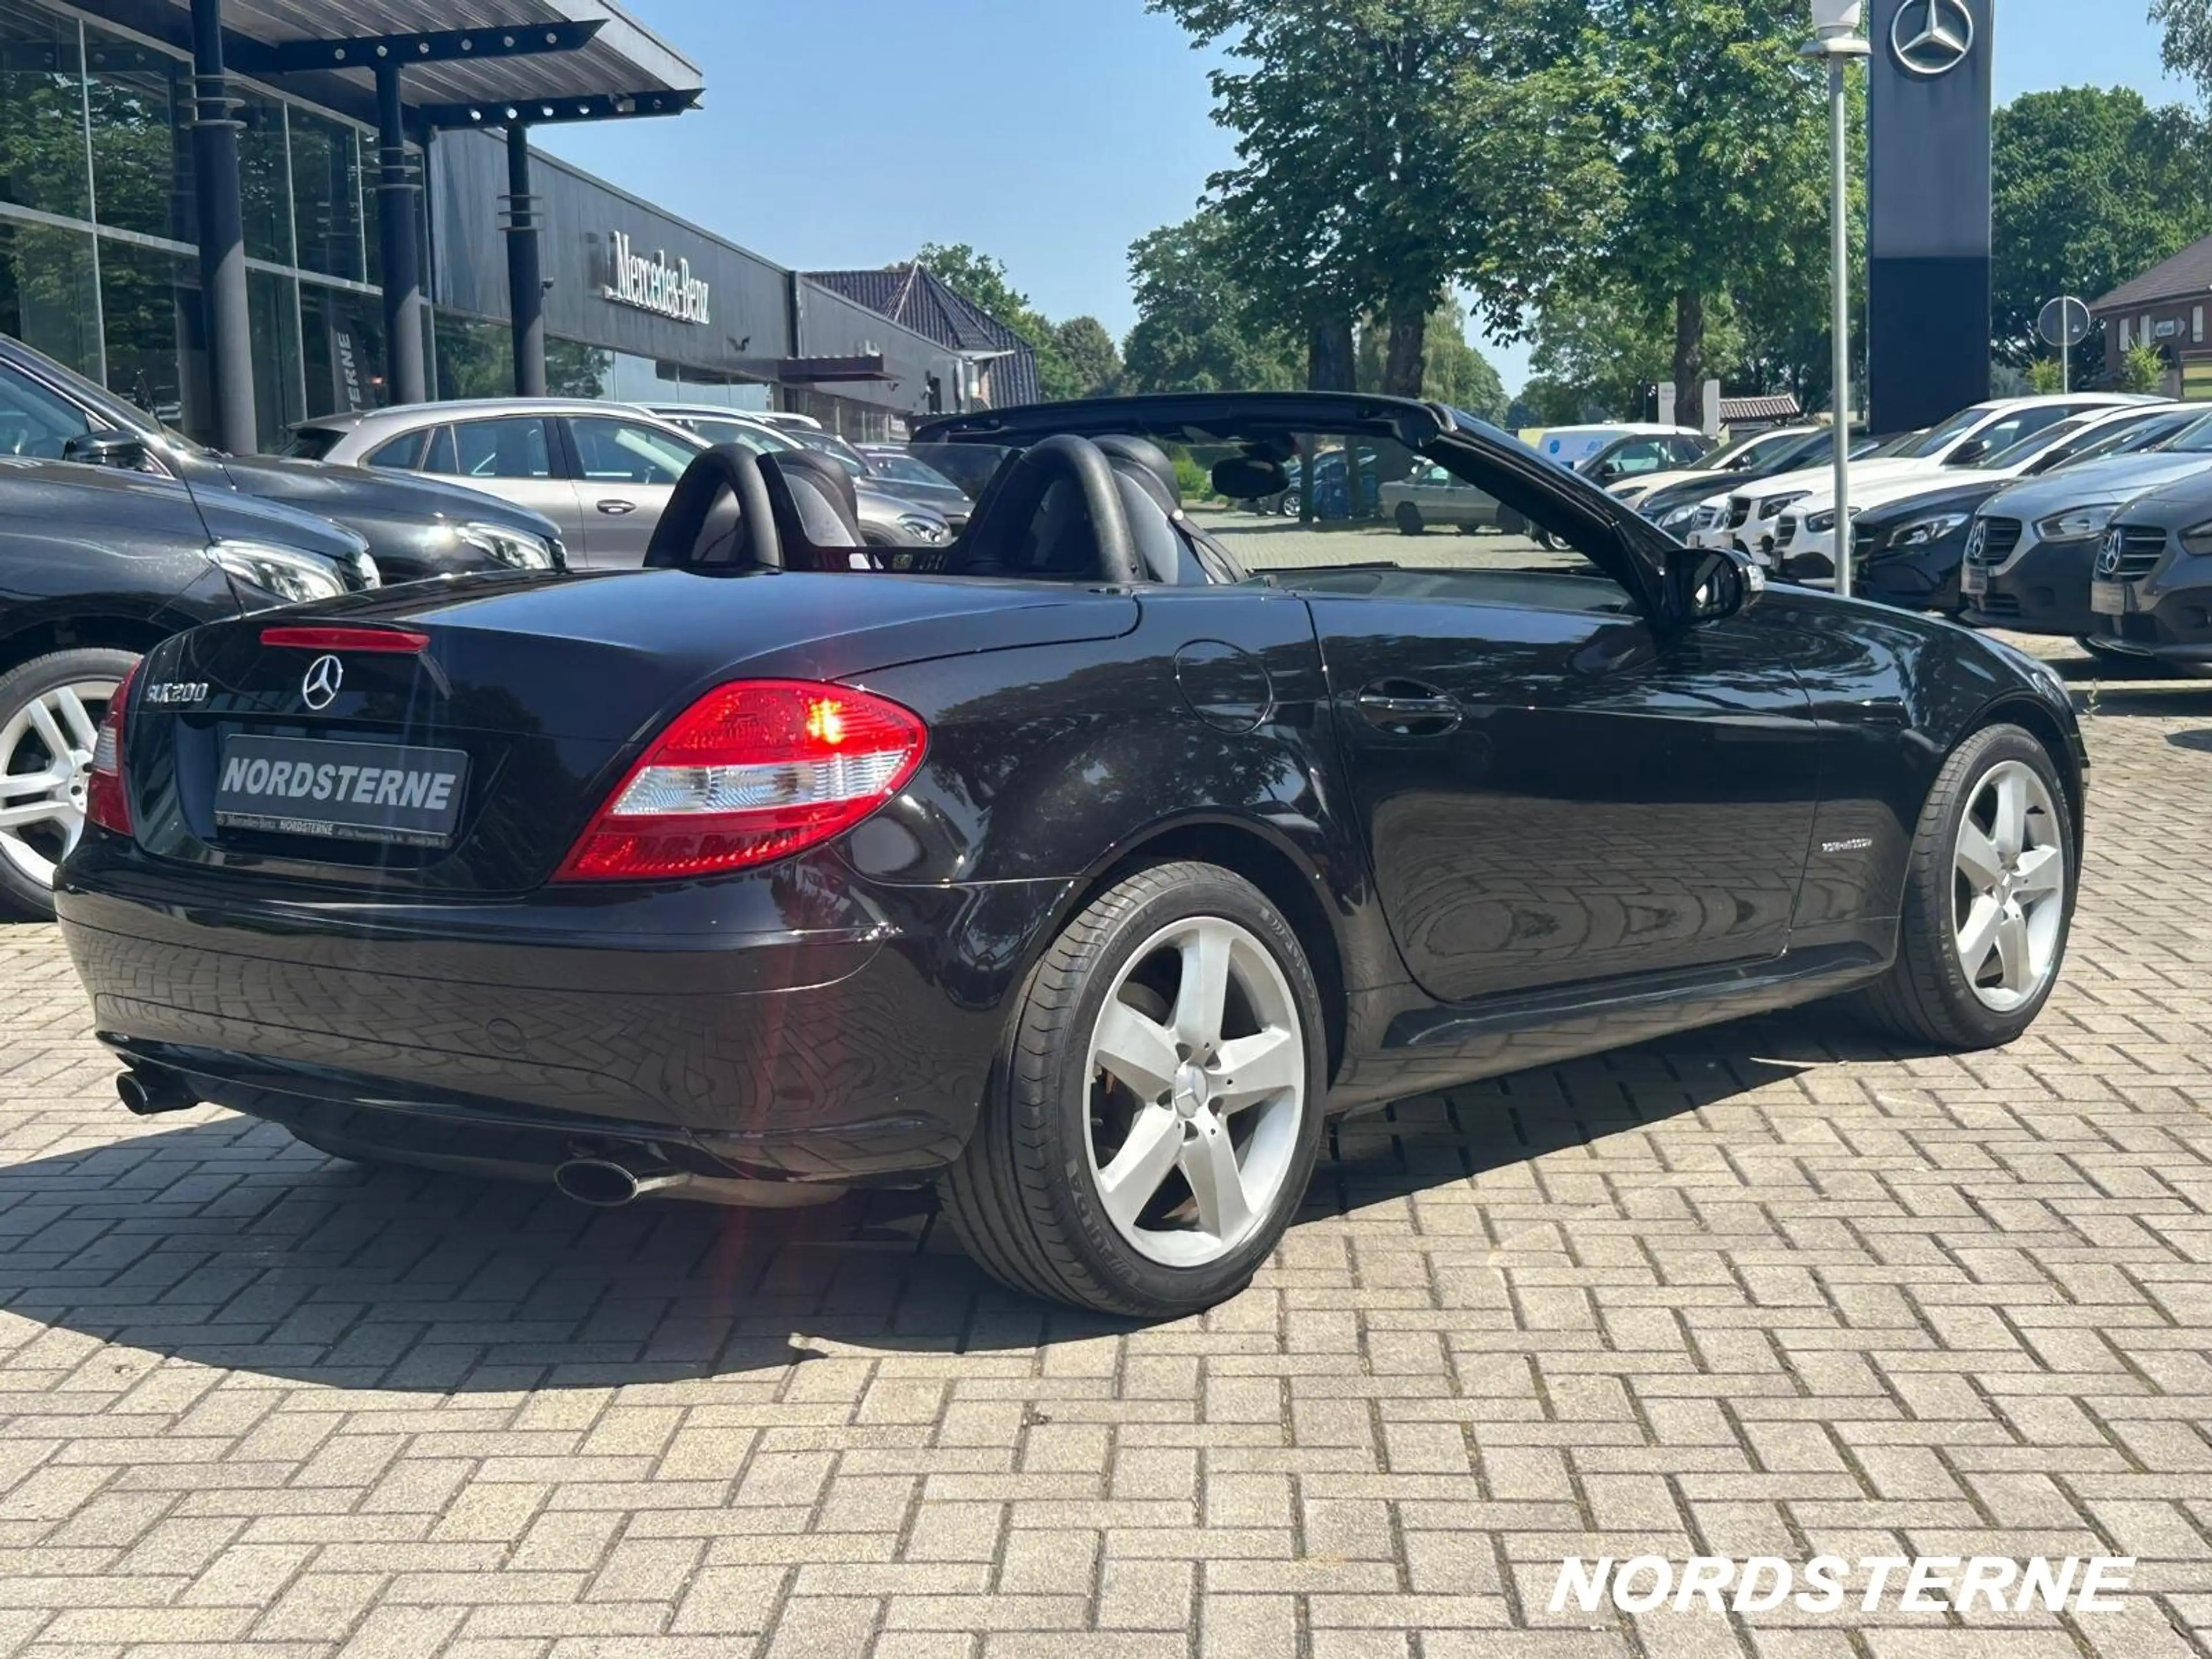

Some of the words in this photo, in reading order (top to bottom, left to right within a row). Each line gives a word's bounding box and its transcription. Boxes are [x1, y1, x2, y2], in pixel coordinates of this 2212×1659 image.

[614, 230, 710, 324] Mercedes-Benz
[221, 757, 456, 810] NORDSTERNE
[280, 819, 334, 835] NORDSTERNE
